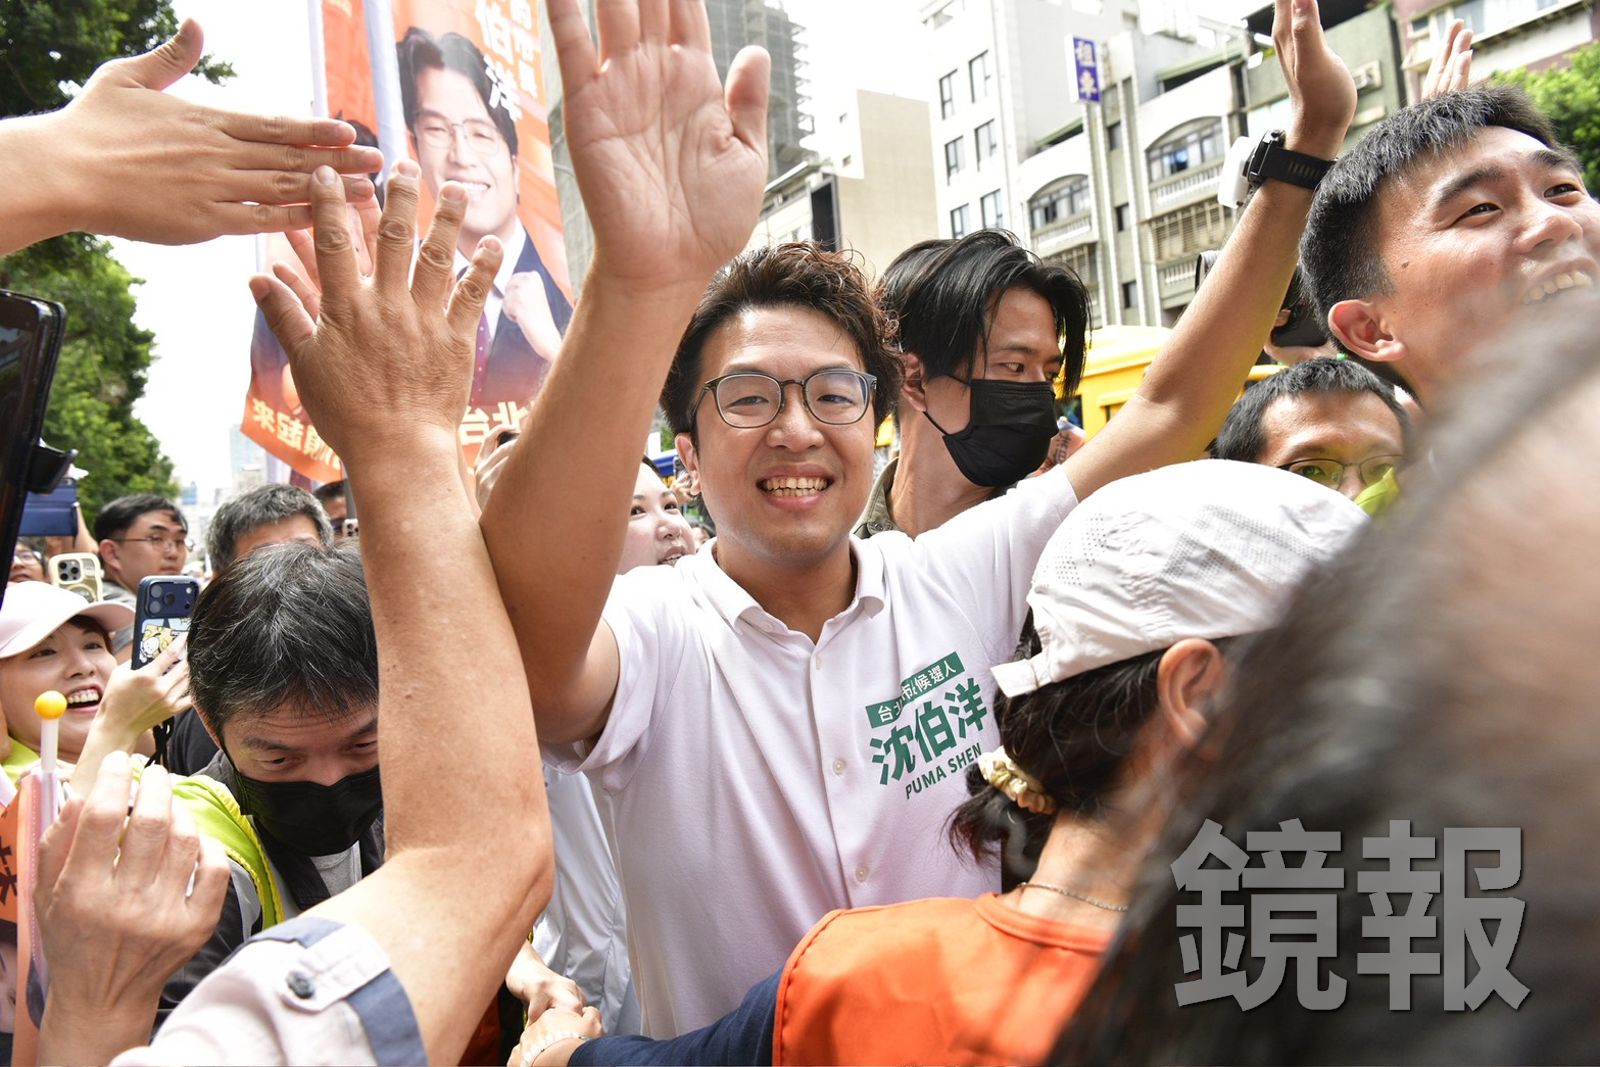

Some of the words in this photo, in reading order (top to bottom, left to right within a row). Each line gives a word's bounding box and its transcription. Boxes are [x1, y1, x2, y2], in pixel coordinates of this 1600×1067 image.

[458, 400, 535, 446] 台北
[869, 677, 988, 786] 沈伯洋
[905, 765, 947, 800] PUMA
[948, 742, 983, 774] SHEN
